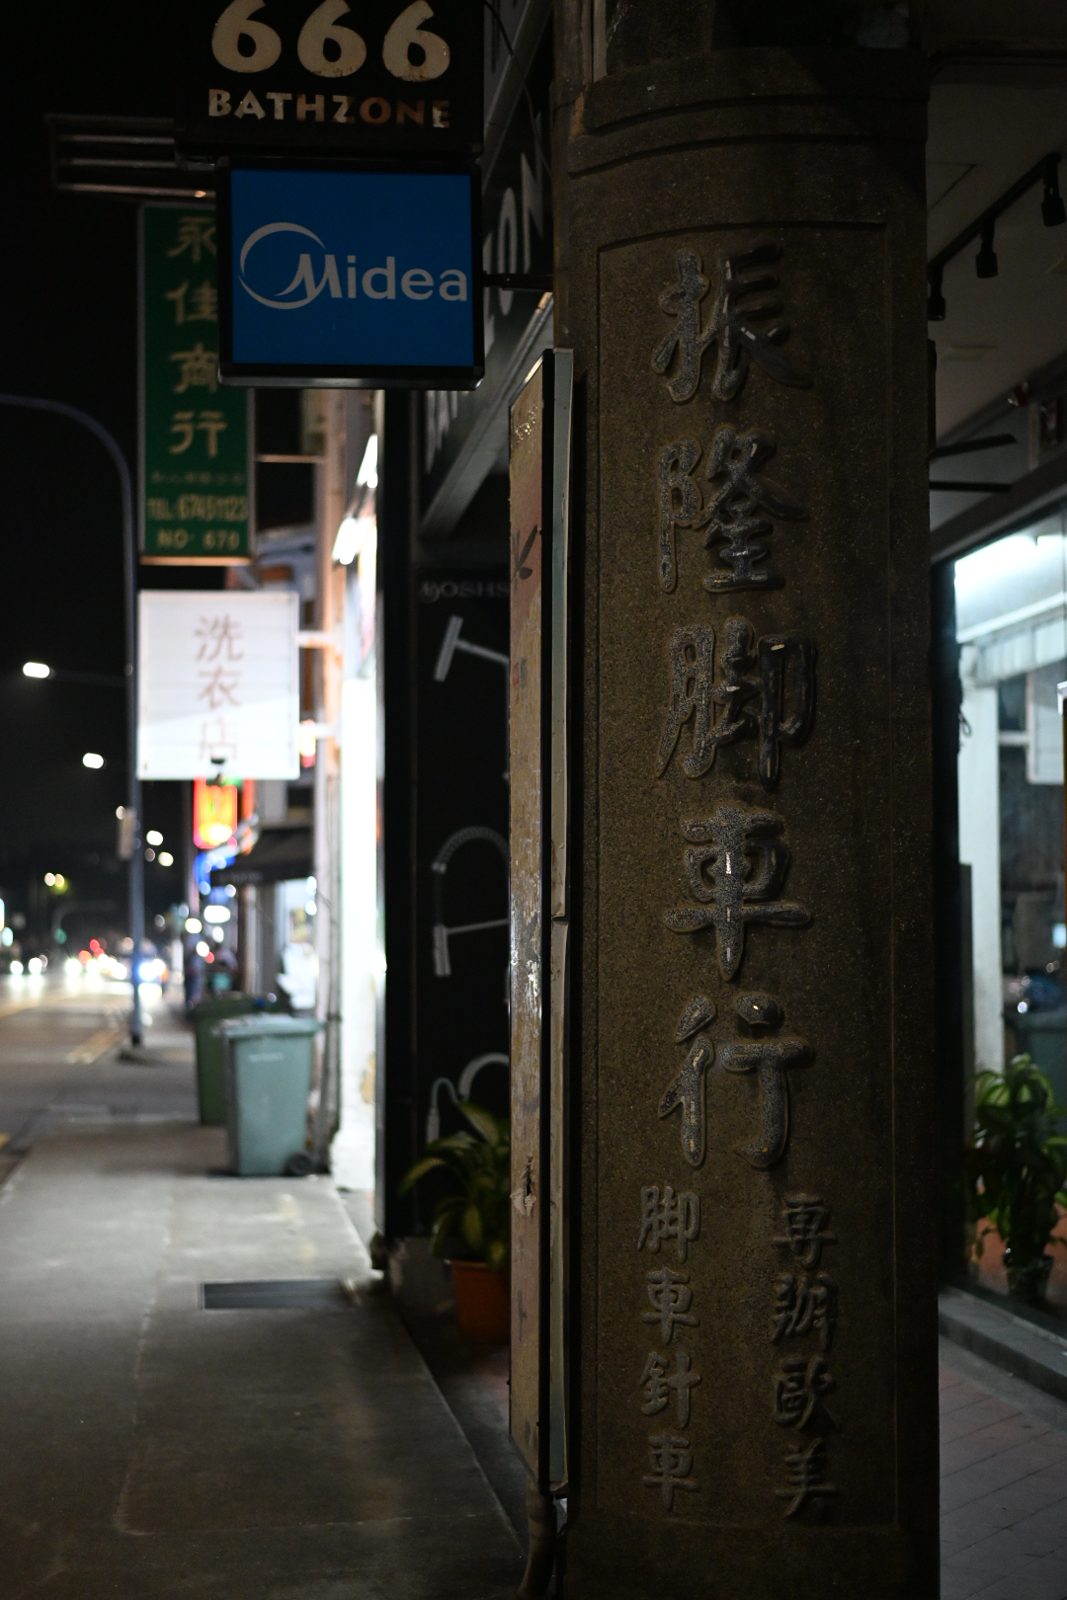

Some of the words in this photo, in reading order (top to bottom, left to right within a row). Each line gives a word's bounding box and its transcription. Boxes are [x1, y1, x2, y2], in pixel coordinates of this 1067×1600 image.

[211, 0, 451, 83] 666
[207, 88, 450, 128] BATHZONE
[273, 253, 468, 301] Midea
